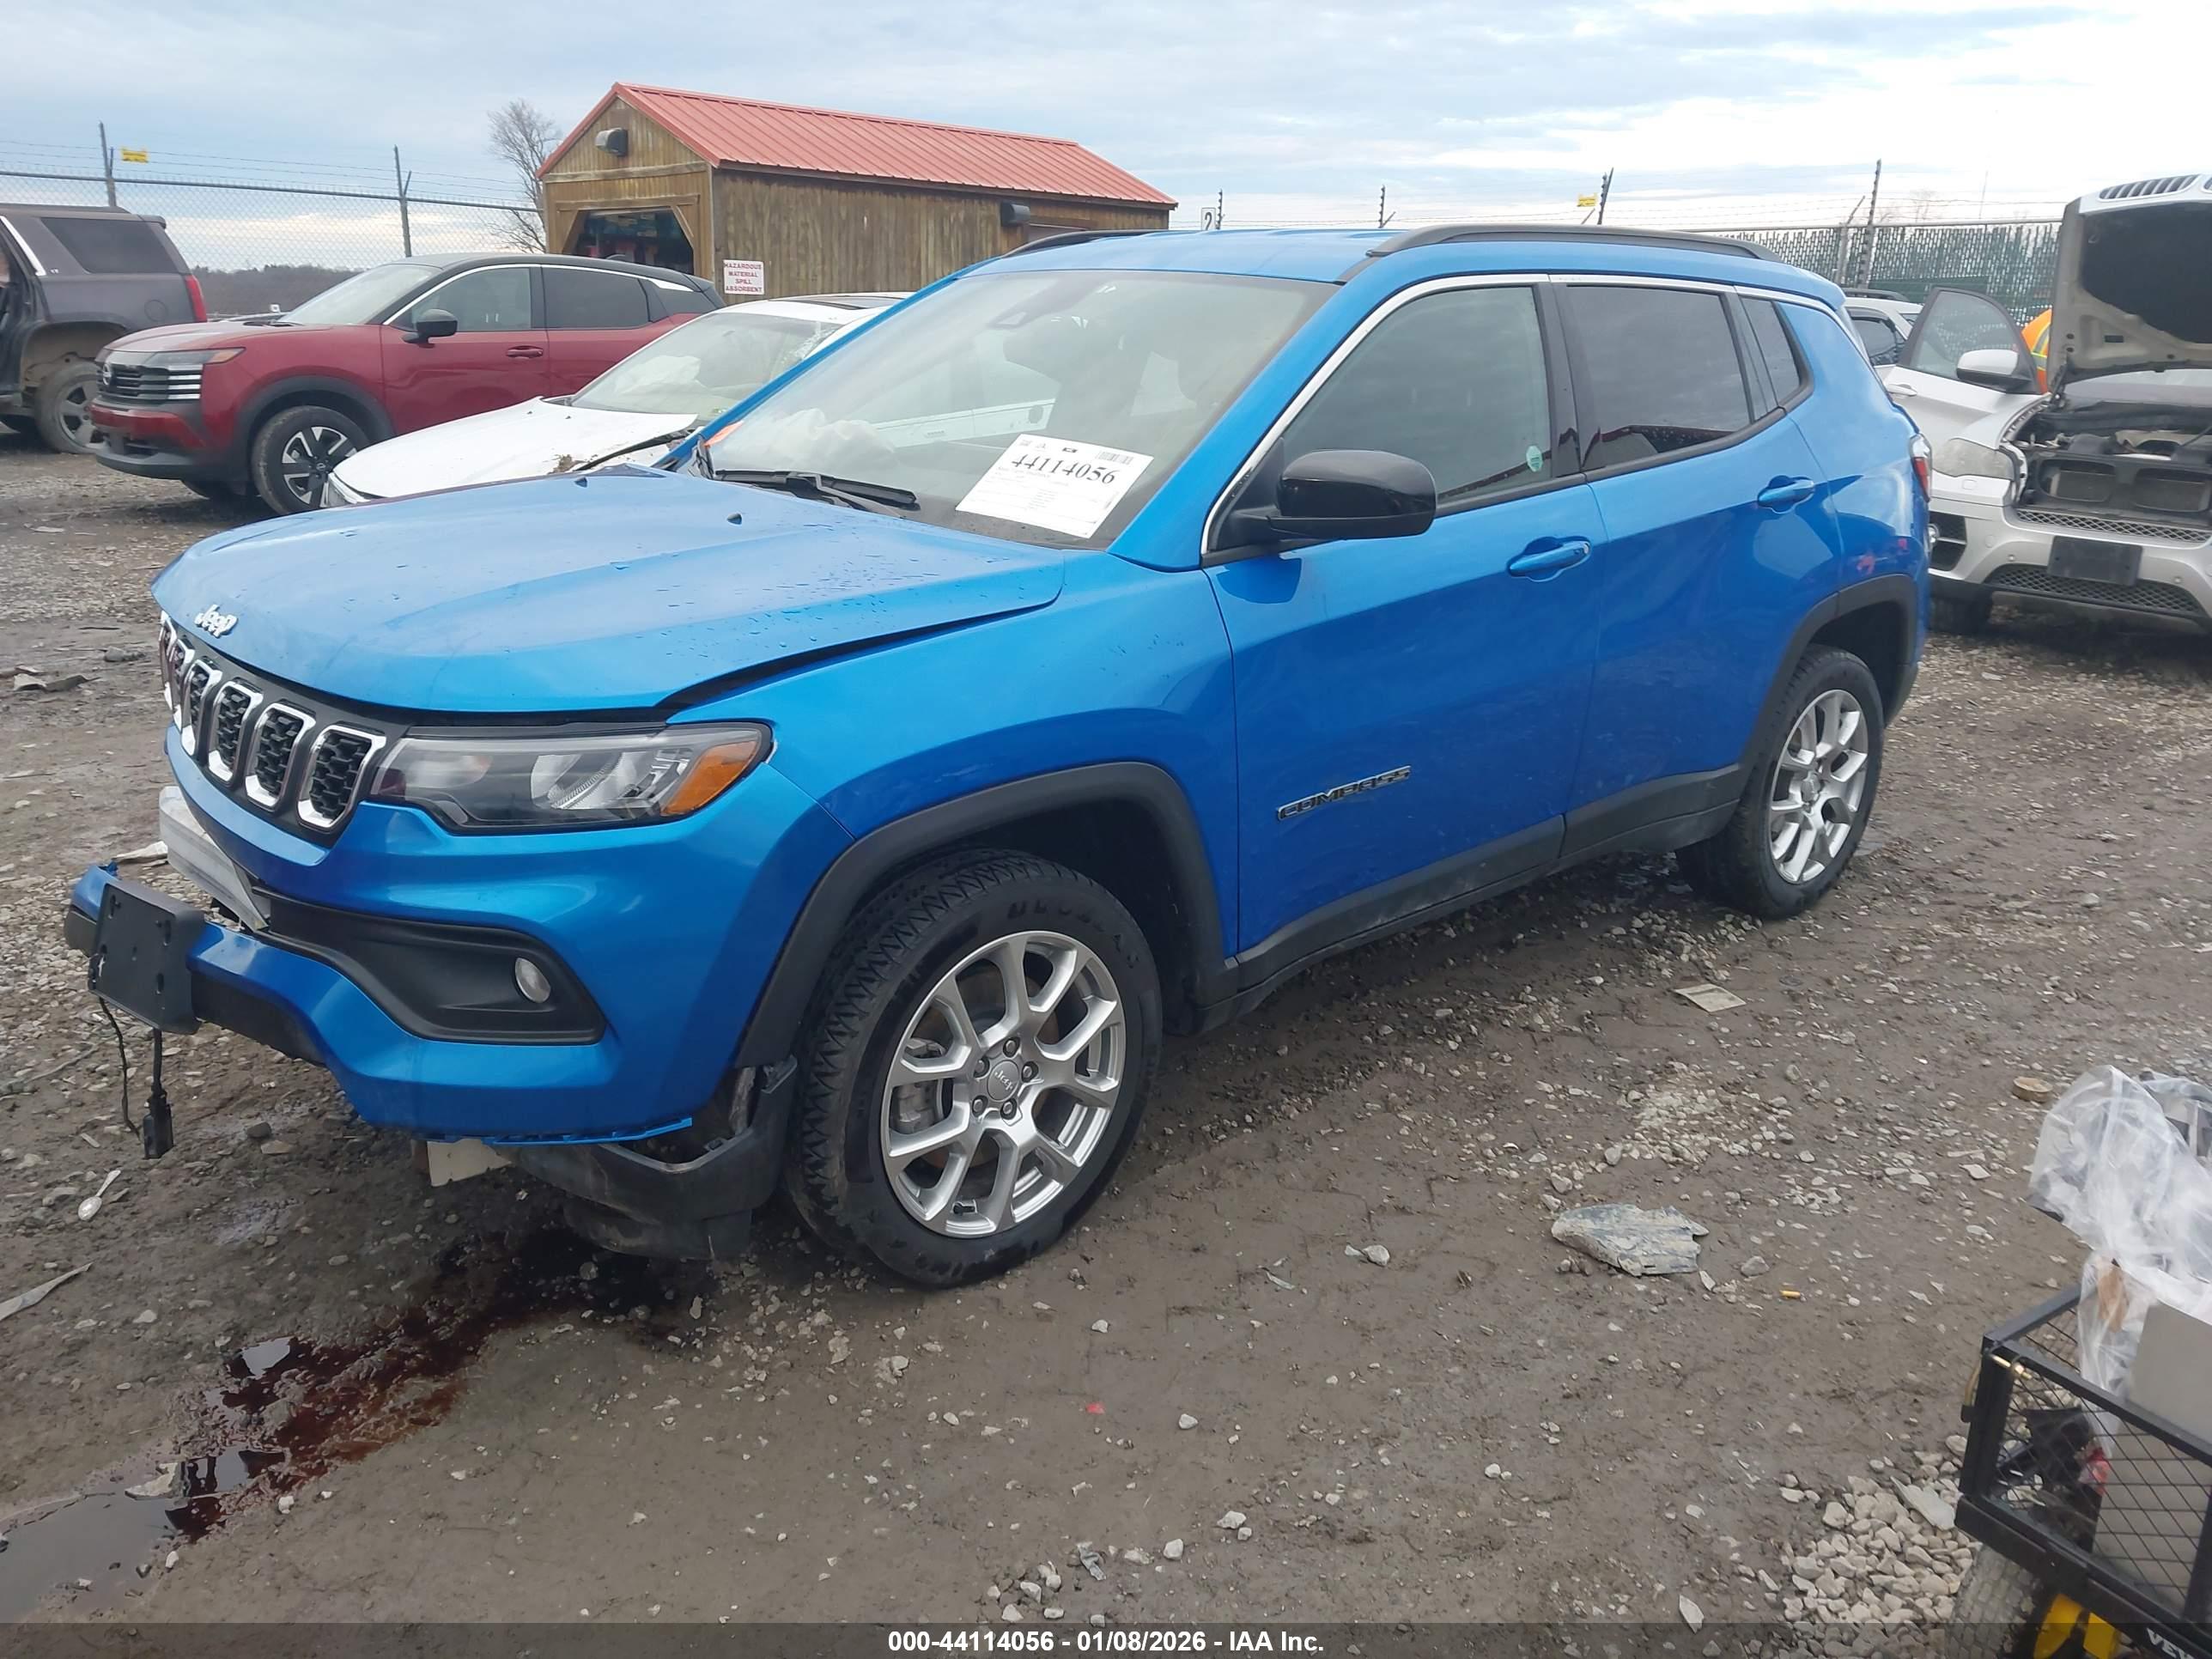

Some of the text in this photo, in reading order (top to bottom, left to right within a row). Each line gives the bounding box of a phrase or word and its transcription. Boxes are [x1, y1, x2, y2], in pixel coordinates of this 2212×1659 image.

[1011, 453, 1120, 484] 44114056
[194, 604, 238, 638] Jeep
[1277, 764, 1413, 822] COMPASS
